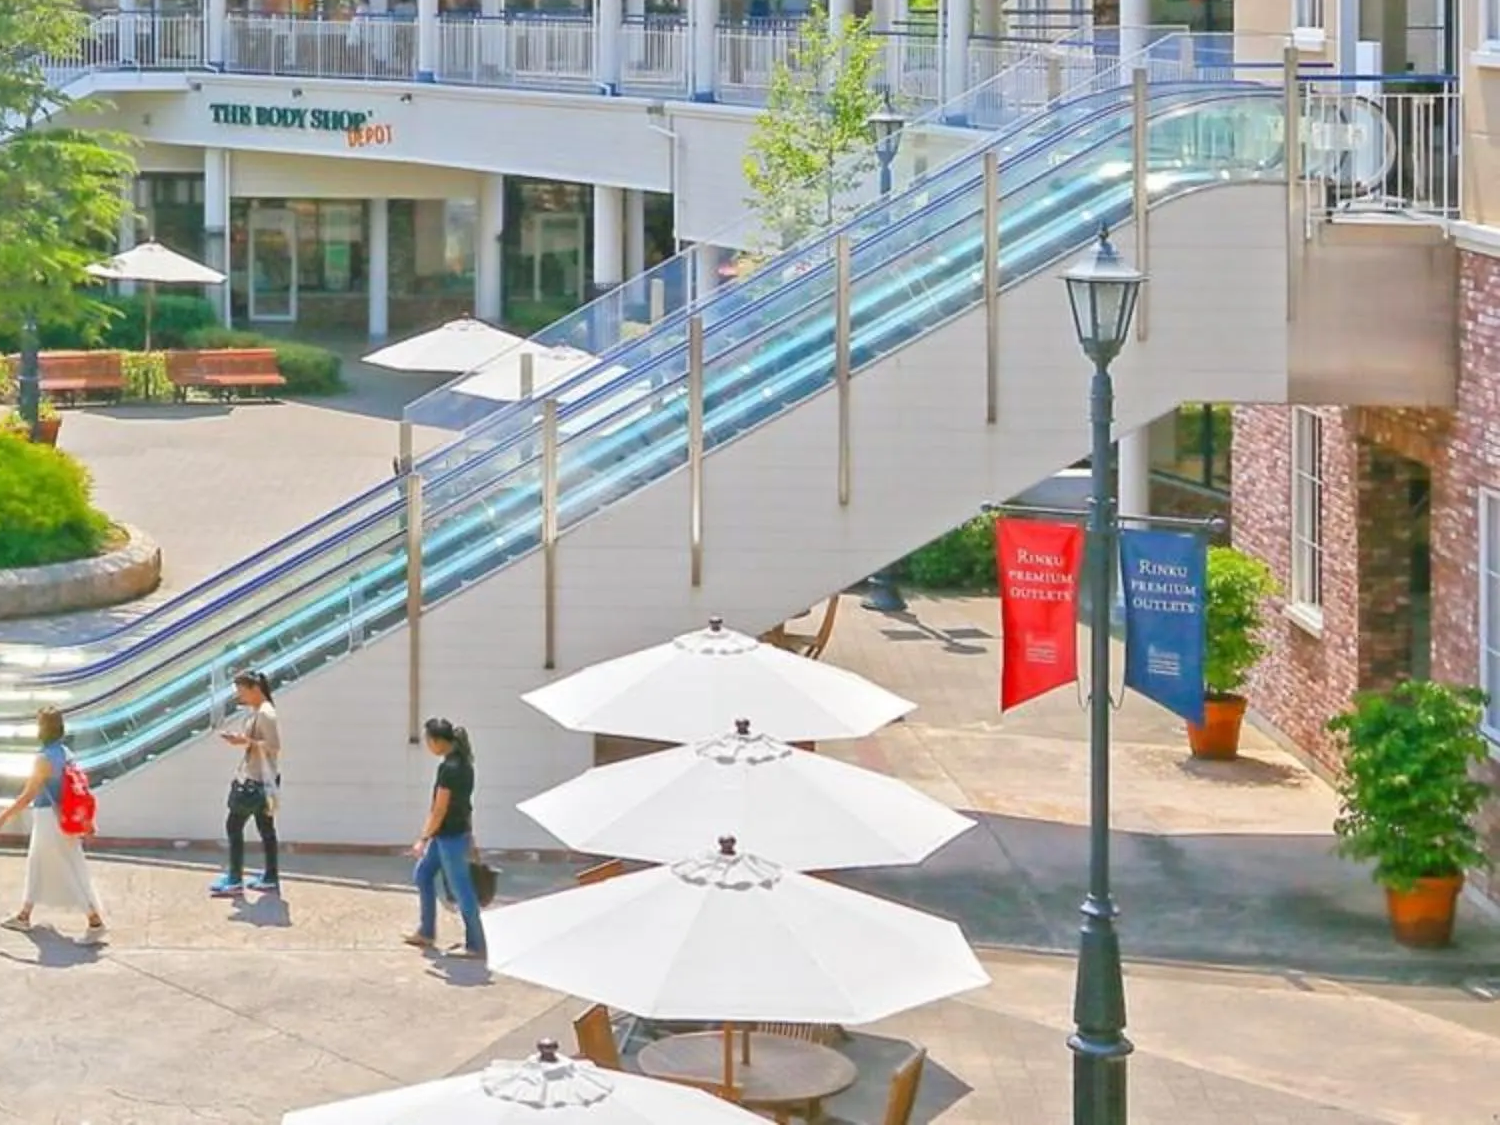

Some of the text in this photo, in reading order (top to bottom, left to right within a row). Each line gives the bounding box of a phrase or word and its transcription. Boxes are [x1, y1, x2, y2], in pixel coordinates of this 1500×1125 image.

[209, 104, 251, 125] THE
[255, 106, 307, 129] BODY
[347, 125, 392, 148] DEPOT
[1008, 570, 1074, 585] PREMIUM
[1139, 559, 1188, 579] RINKU
[1131, 579, 1196, 597] PREMIUM
[1132, 596, 1196, 614] OUTLETS
